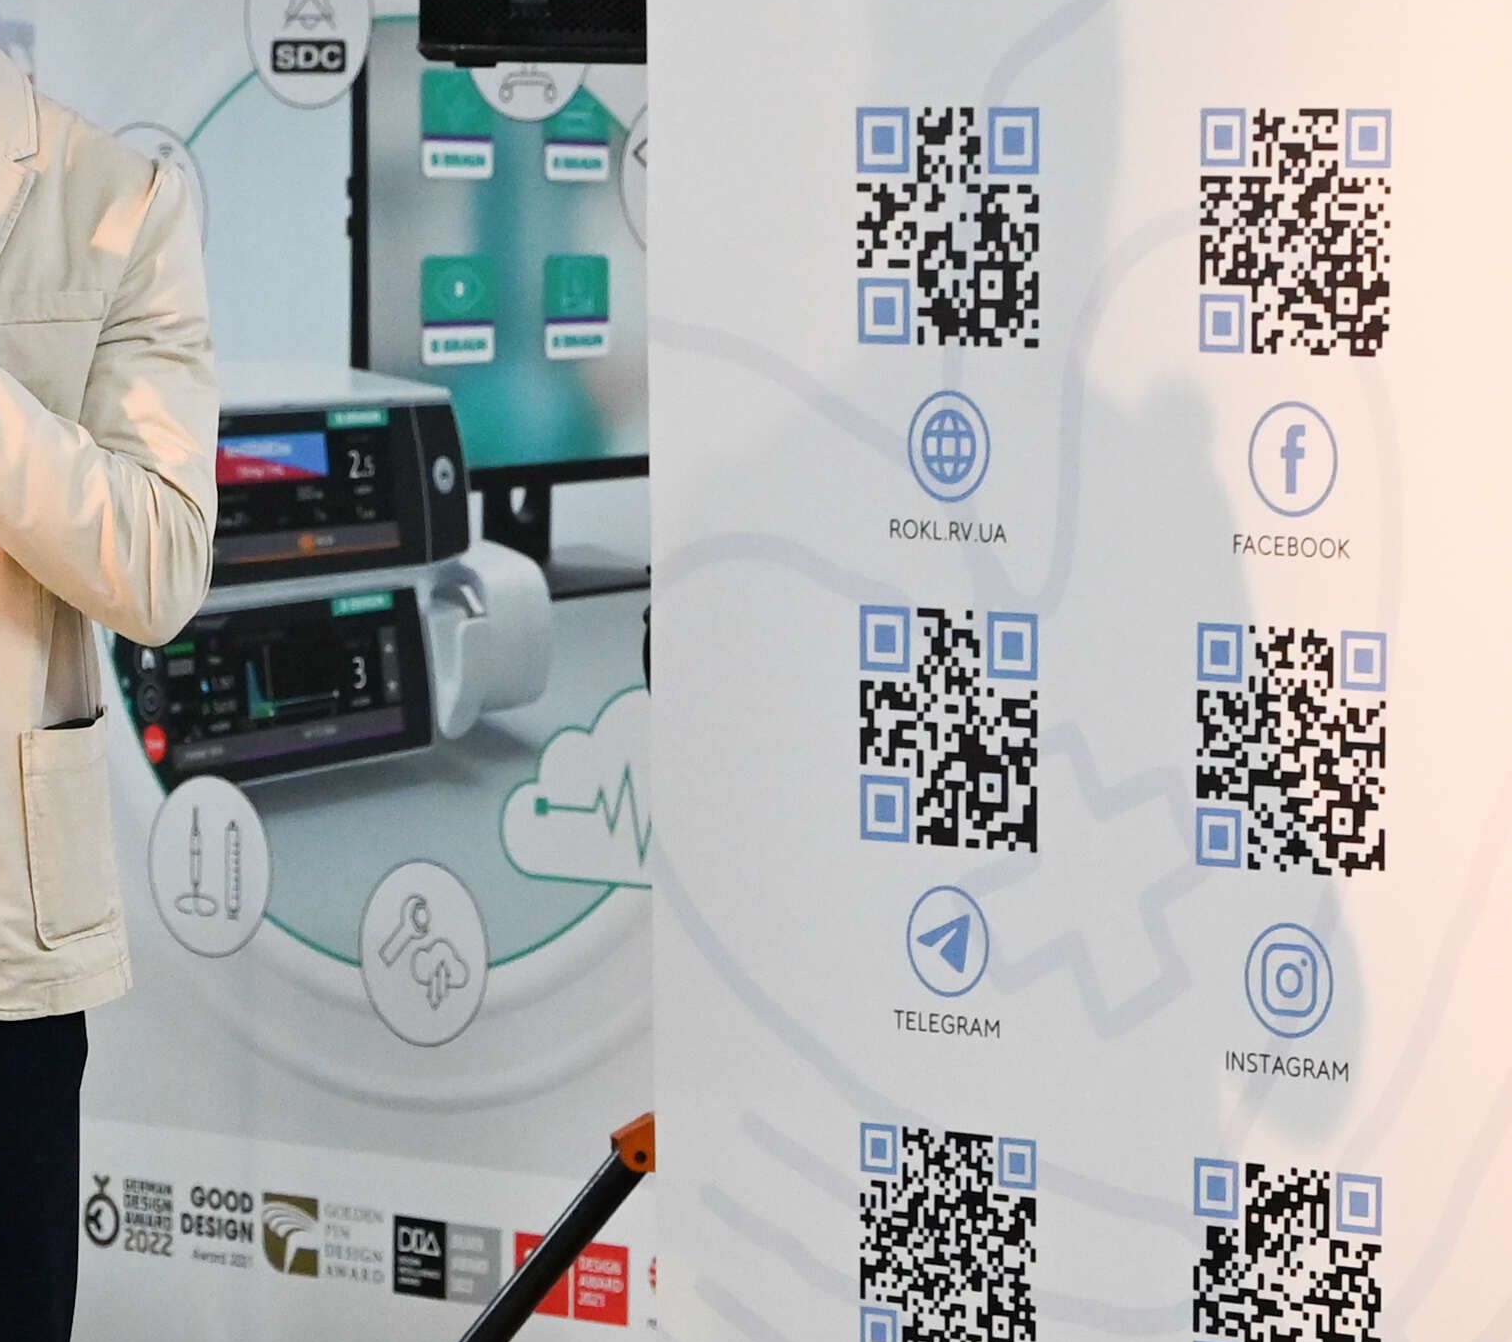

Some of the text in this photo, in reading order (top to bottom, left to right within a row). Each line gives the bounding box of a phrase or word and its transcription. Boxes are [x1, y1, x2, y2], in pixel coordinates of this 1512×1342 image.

[275, 43, 342, 71] SDC
[889, 518, 1007, 544] ROKL.RV.UA
[1232, 533, 1350, 559] FACEBOOK
[893, 1009, 1001, 1039] TELEGRAM
[1225, 1050, 1349, 1082] INSTAGRAM
[190, 1185, 255, 1214] GOOD
[124, 1228, 174, 1257] 2022
[180, 1212, 255, 1244] DESIGN
